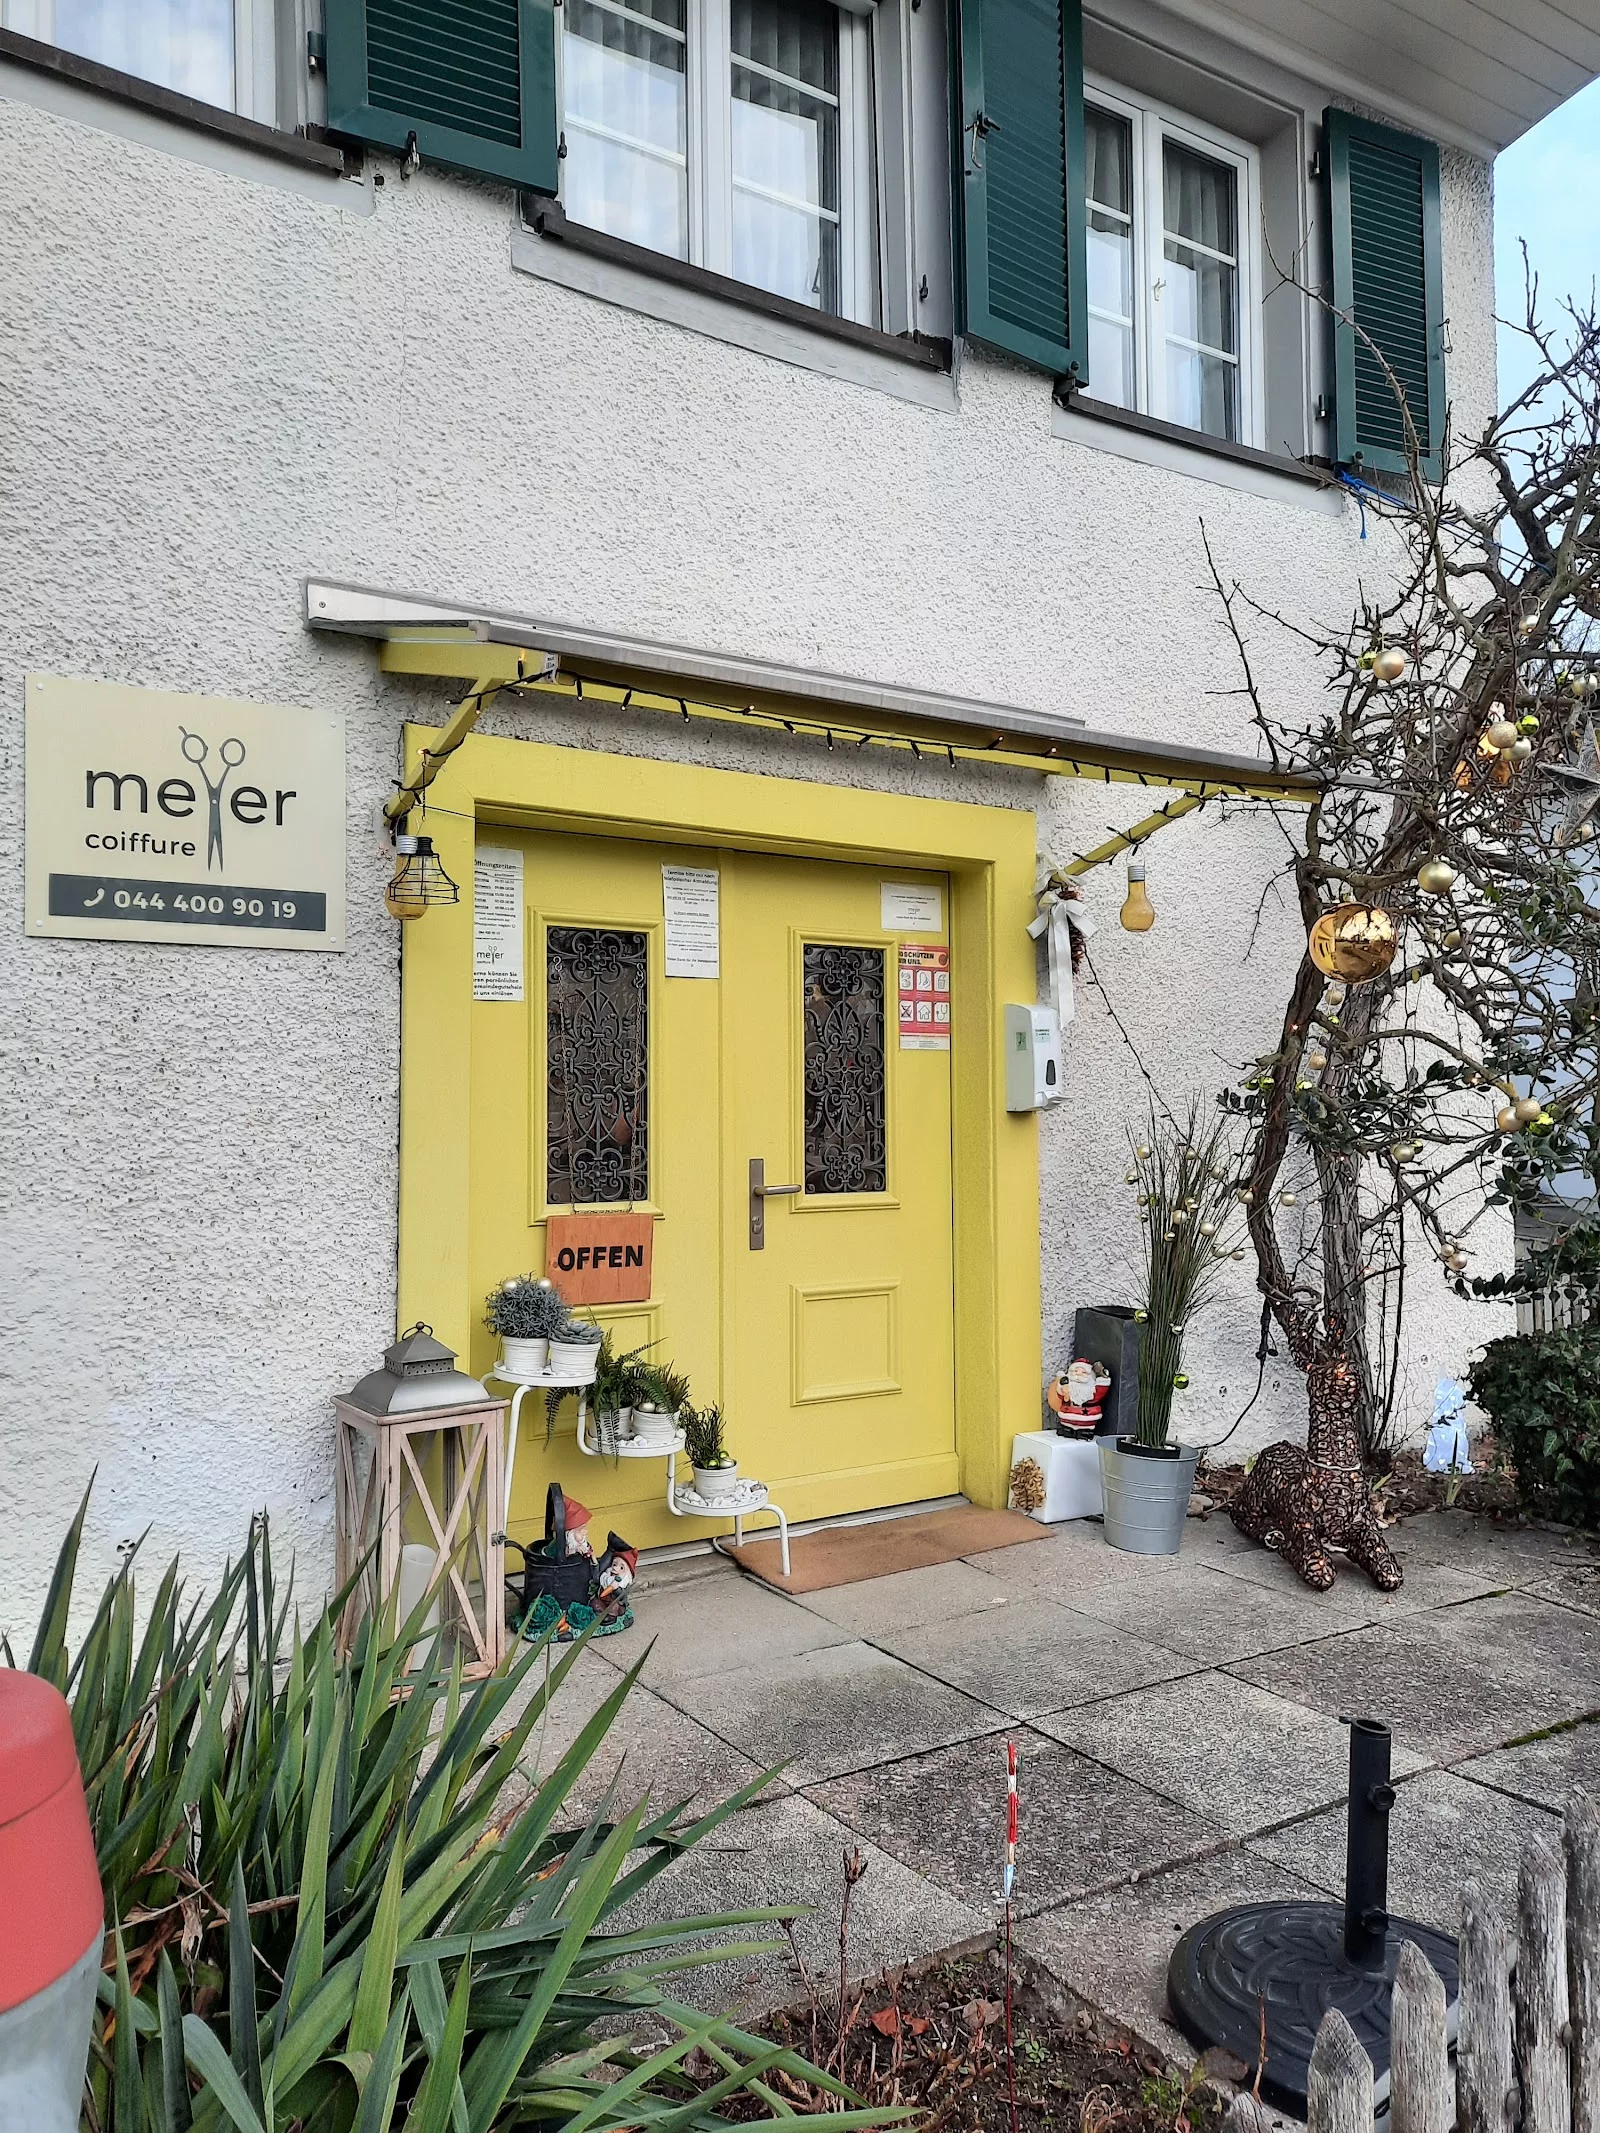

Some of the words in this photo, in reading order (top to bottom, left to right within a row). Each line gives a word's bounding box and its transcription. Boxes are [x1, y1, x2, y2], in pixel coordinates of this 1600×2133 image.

[85, 831, 196, 856] coiffure
[113, 889, 165, 911] 044
[173, 893, 224, 914] 400
[233, 898, 264, 917] 90
[271, 899, 297, 919] 19
[904, 951, 935, 959] SCHÜTZEN
[557, 1245, 644, 1272] OFFEN
